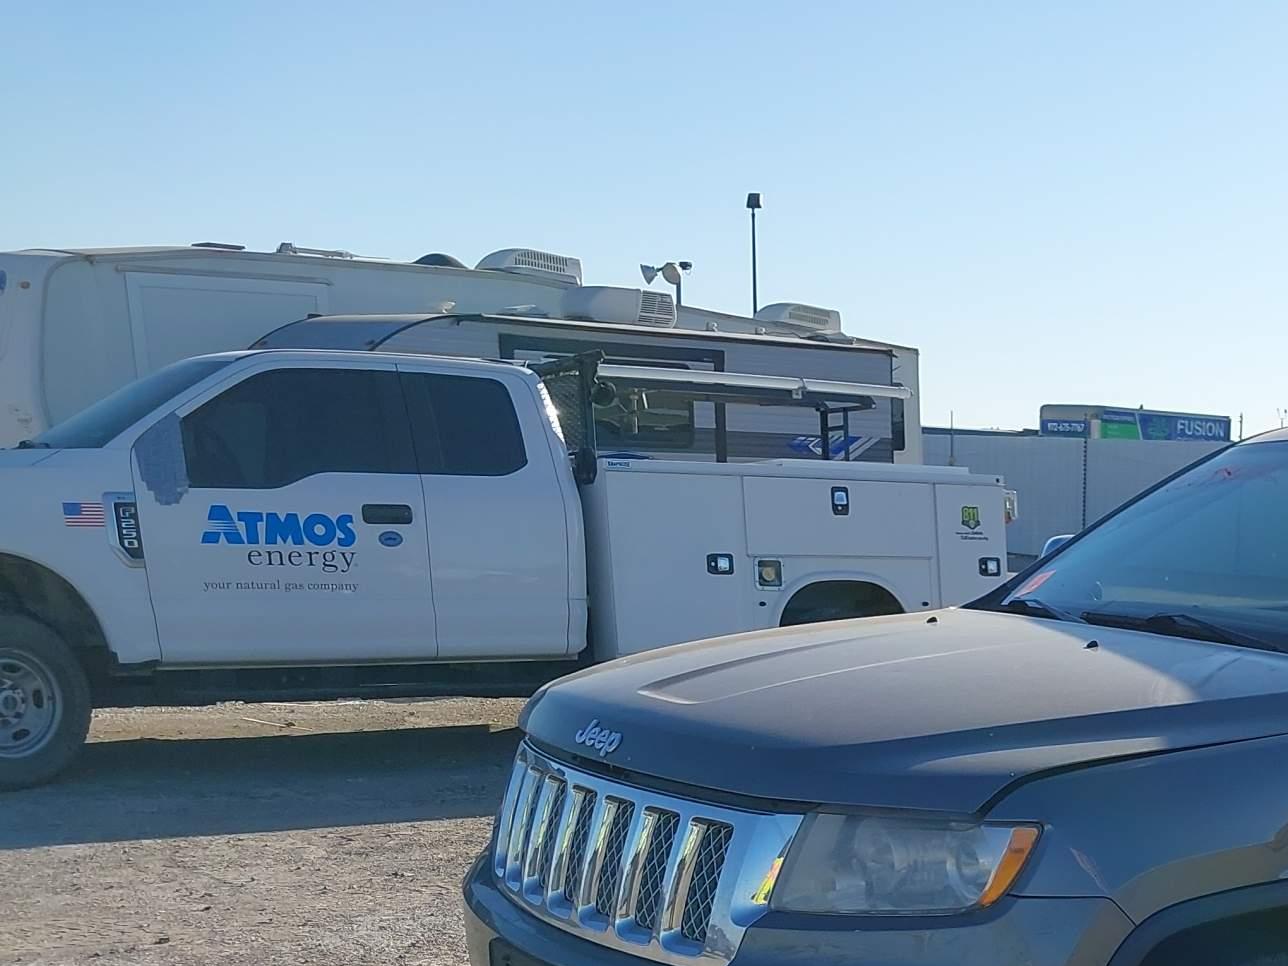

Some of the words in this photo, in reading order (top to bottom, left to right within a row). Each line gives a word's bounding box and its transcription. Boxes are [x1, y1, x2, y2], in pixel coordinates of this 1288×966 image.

[1176, 419, 1225, 437] FUSION
[119, 506, 139, 548] F250
[201, 504, 357, 548] ATMOS
[247, 549, 357, 573] energy
[203, 579, 232, 592] your
[236, 580, 280, 590] natural
[284, 582, 304, 592] gas
[307, 581, 359, 592] company
[575, 719, 622, 757] Jeep
